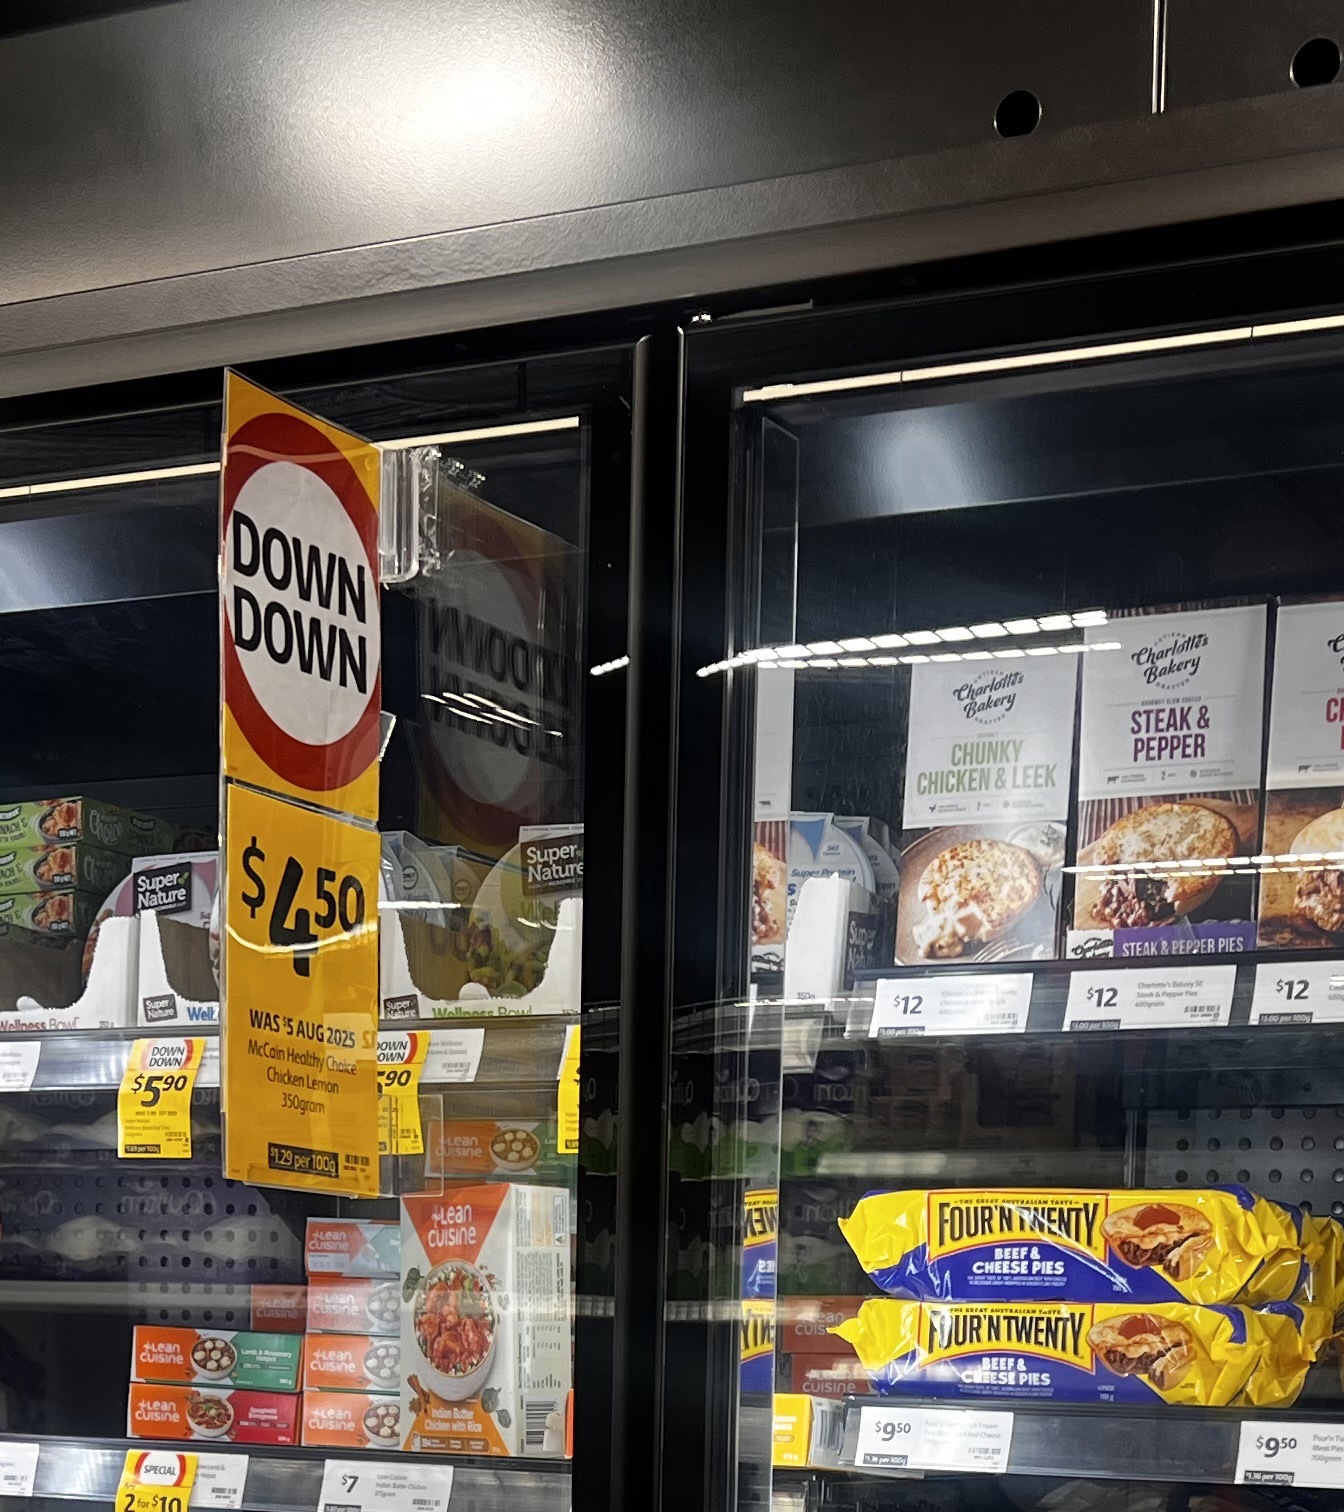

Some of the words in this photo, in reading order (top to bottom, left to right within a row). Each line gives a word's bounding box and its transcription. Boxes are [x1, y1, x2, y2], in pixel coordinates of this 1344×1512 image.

[232, 510, 367, 624] DOWN
[233, 585, 367, 695] DOWN
[1143, 651, 1202, 686] Bakery
[963, 688, 1017, 723] Bakery
[1130, 707, 1190, 734] STEAK
[1196, 706, 1210, 729] &
[950, 739, 1024, 768] CHUNKY
[1133, 731, 1207, 761] PEPPER
[917, 769, 991, 796] CHICKEN
[993, 768, 1009, 790] &
[1011, 763, 1058, 790] LEEK
[137, 874, 178, 892] Super
[138, 885, 187, 907] Nature
[1122, 941, 1158, 957] STEAK
[1160, 941, 1168, 954] &
[1171, 939, 1215, 954] PEPPER
[1218, 937, 1244, 952] PIES
[1087, 987, 1118, 1008] $12
[49, 1017, 80, 1031] Bowl
[249, 1009, 280, 1033] WAS
[282, 1014, 295, 1037] $5
[297, 1018, 324, 1044] AUG
[326, 1025, 356, 1050] 2025
[248, 1040, 284, 1067] McCain
[286, 1045, 325, 1074] Healthy
[326, 1054, 357, 1077] Choice
[267, 1066, 304, 1088] Chicken
[307, 1073, 339, 1095] Lemon
[281, 1092, 325, 1115] 350gram
[270, 1148, 293, 1169] $1.29
[294, 1156, 310, 1172] per
[312, 1155, 337, 1177] 100g
[972, 1261, 1028, 1276] CHEESE
[1031, 1261, 1065, 1275] PIES
[341, 1474, 359, 1494] $7
[124, 1493, 136, 1512] 2
[137, 1499, 151, 1510] for
